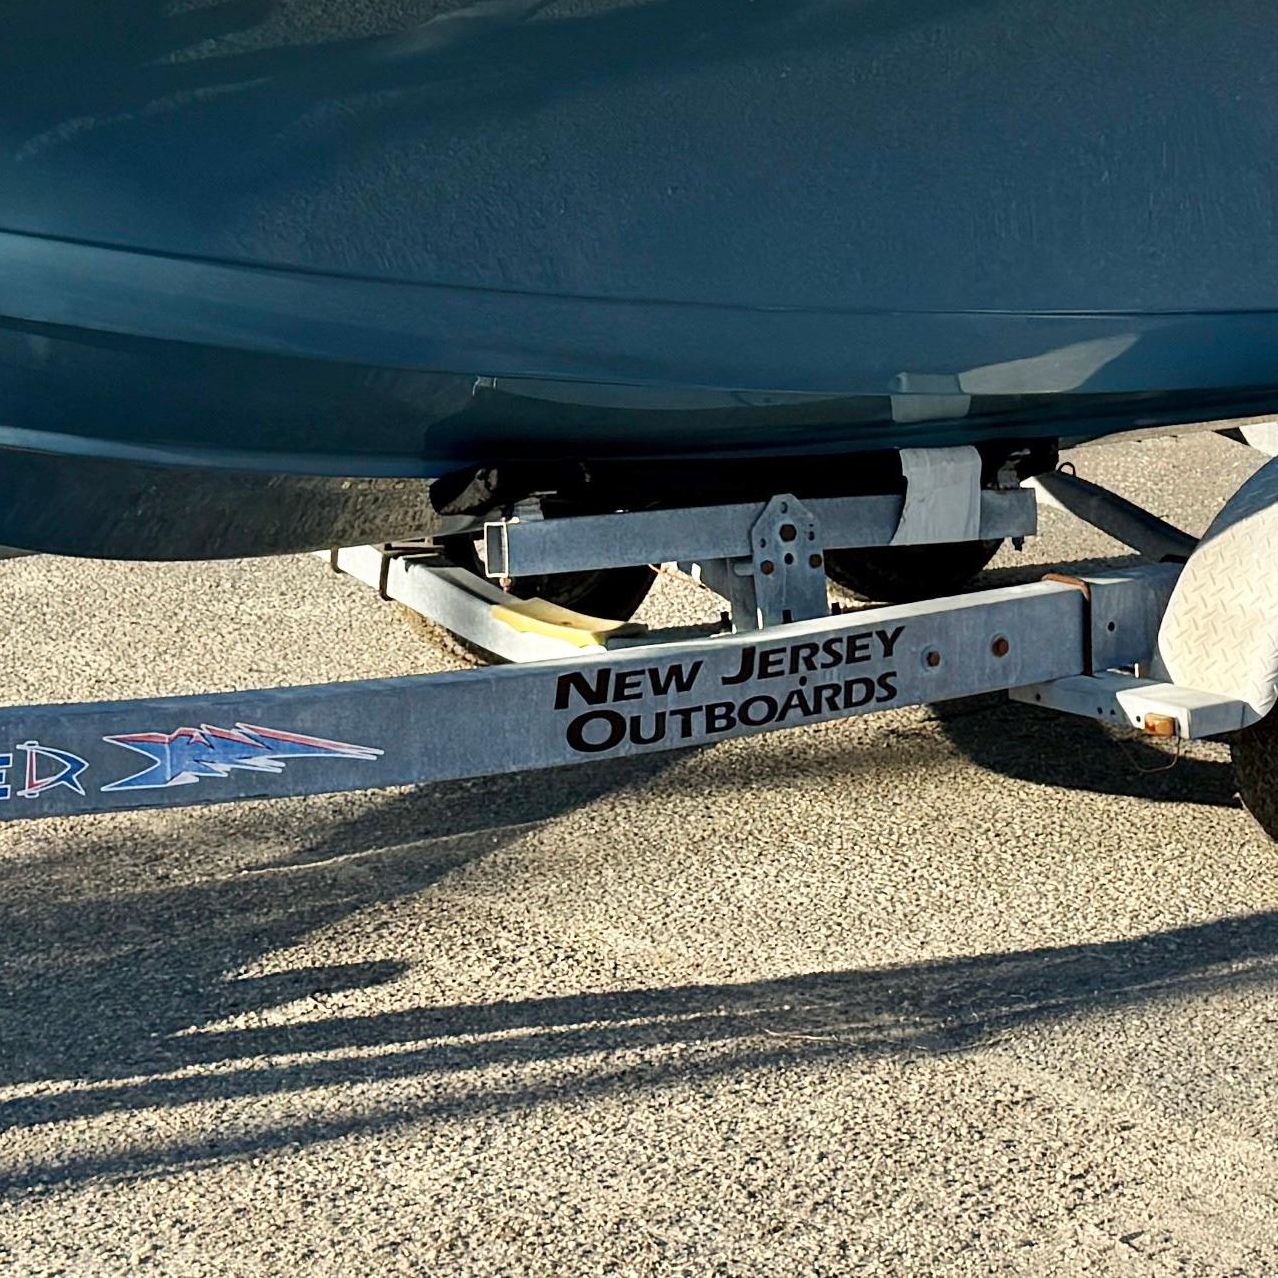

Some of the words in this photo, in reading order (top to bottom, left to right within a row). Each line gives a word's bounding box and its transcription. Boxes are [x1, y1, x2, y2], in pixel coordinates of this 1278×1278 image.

[554, 660, 704, 710] NEW
[722, 626, 906, 686] JERSEY
[566, 670, 898, 753] OUTBOARDS
